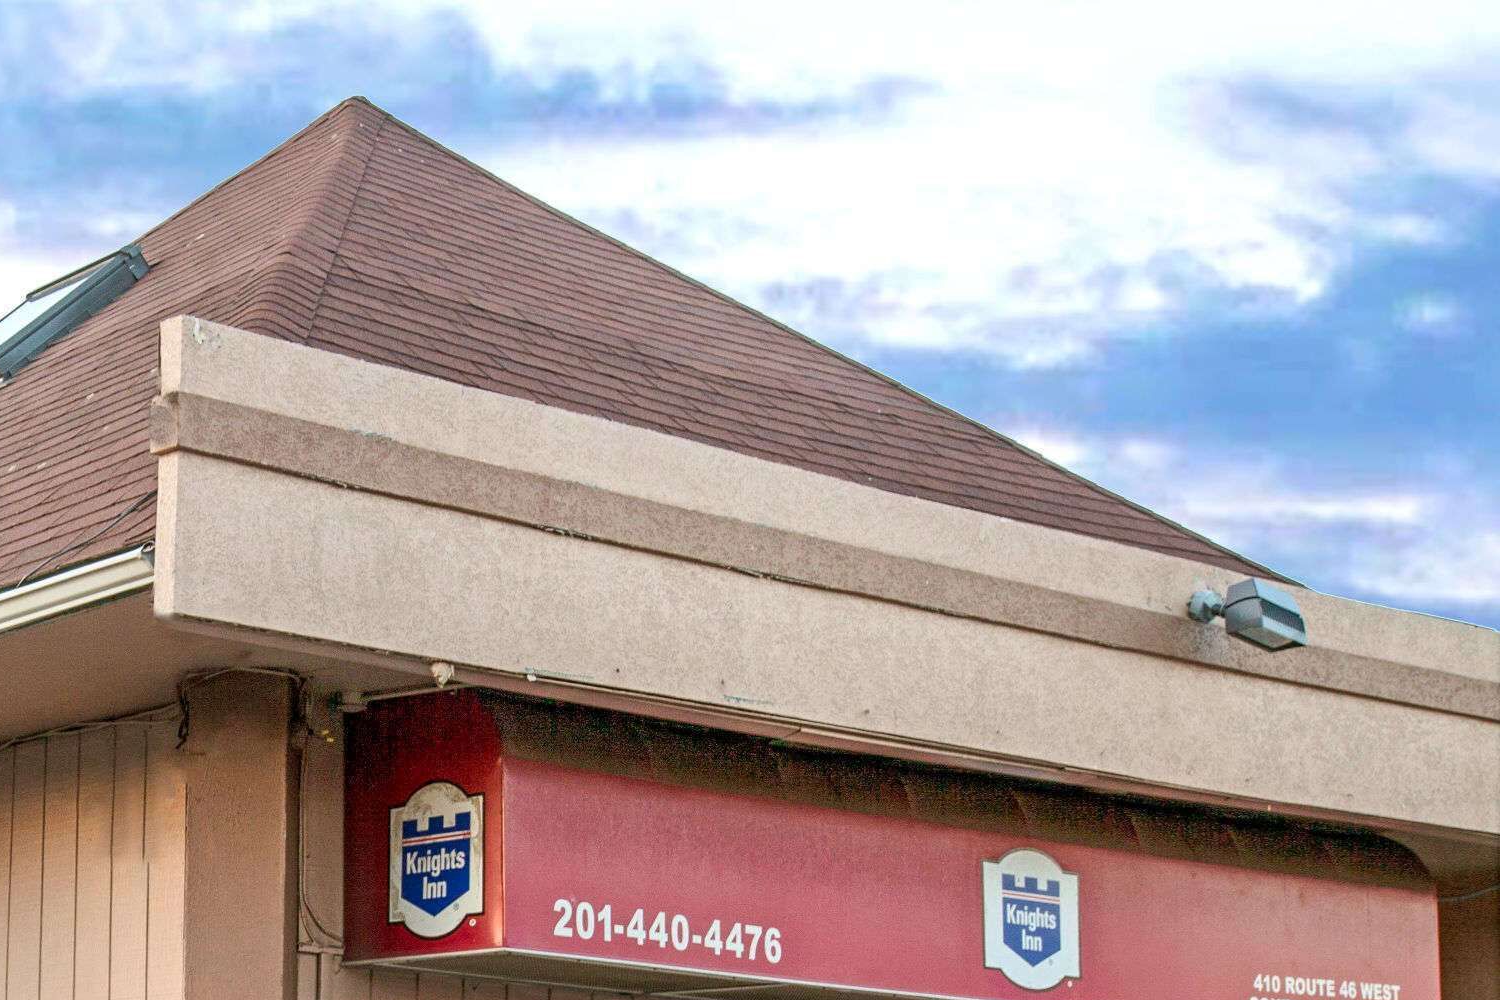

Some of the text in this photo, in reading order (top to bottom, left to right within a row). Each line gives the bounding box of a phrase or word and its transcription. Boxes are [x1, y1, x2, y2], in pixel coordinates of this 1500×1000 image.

[406, 848, 465, 876] Knights
[422, 876, 447, 900] Inn
[1006, 903, 1057, 932] Knights
[553, 898, 782, 964] 201-440-4476
[1021, 928, 1043, 952] Inn
[1253, 974, 1280, 994] 410
[1285, 976, 1335, 997] ROUTE
[1339, 980, 1357, 999] 46
